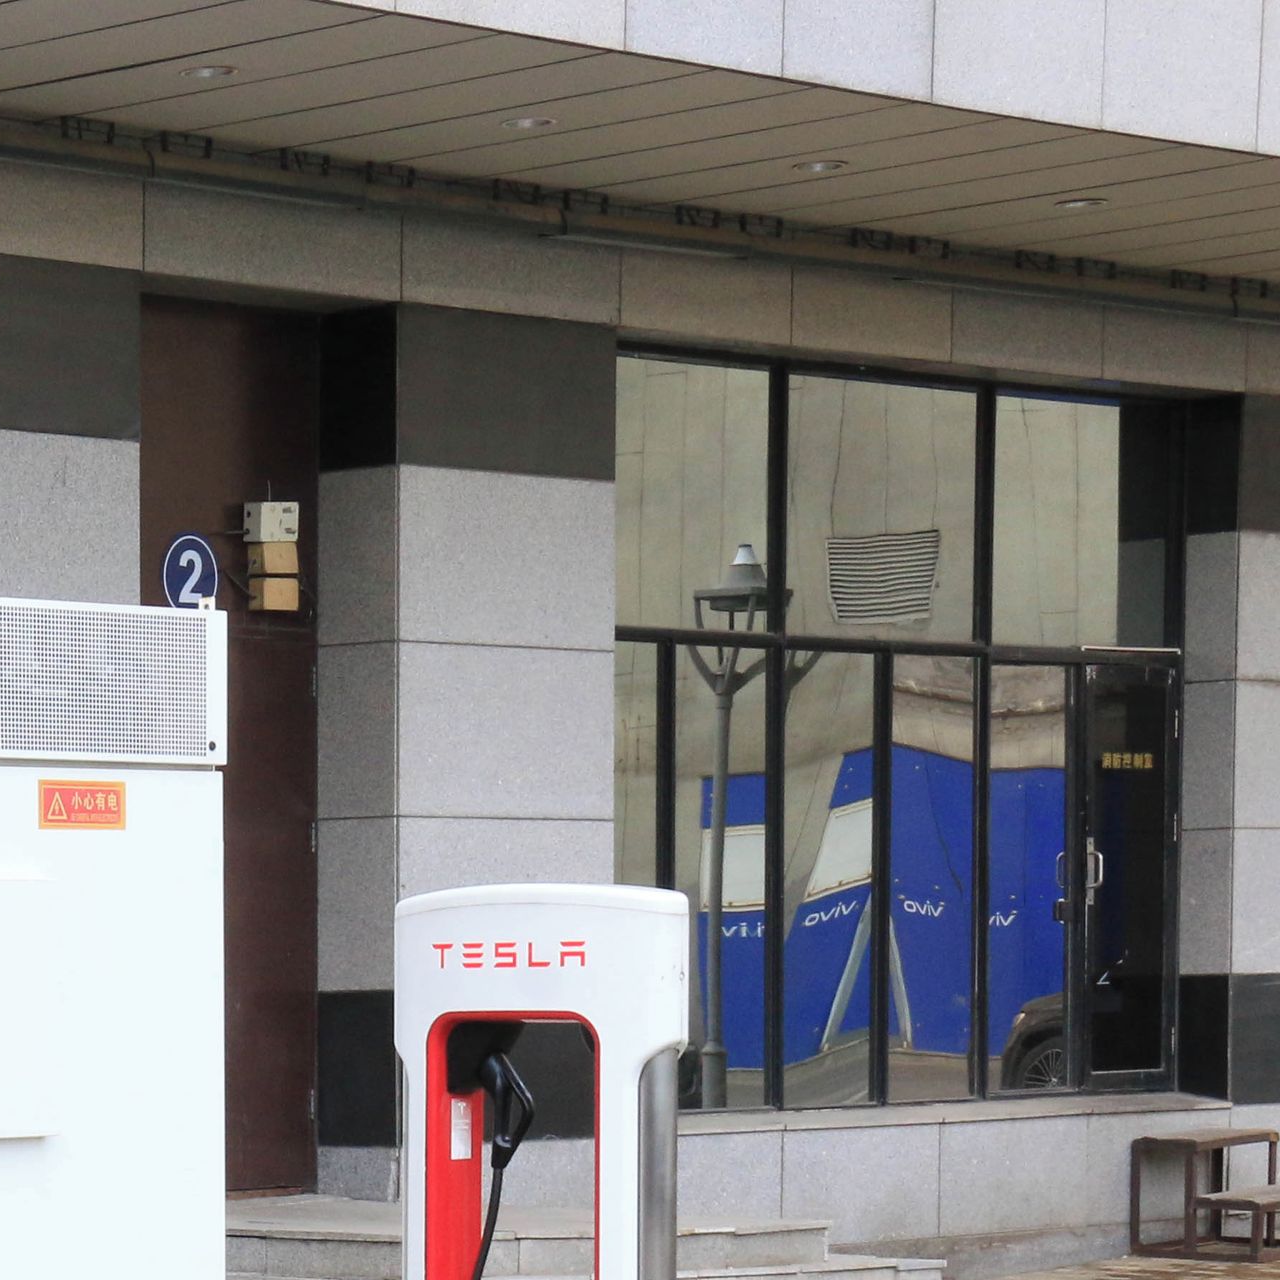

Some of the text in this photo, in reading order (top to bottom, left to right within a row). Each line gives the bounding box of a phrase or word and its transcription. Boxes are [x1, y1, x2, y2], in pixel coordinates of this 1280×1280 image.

[178, 549, 203, 604] 2
[71, 792, 119, 811] 小心有电
[431, 940, 587, 969] TESLA
